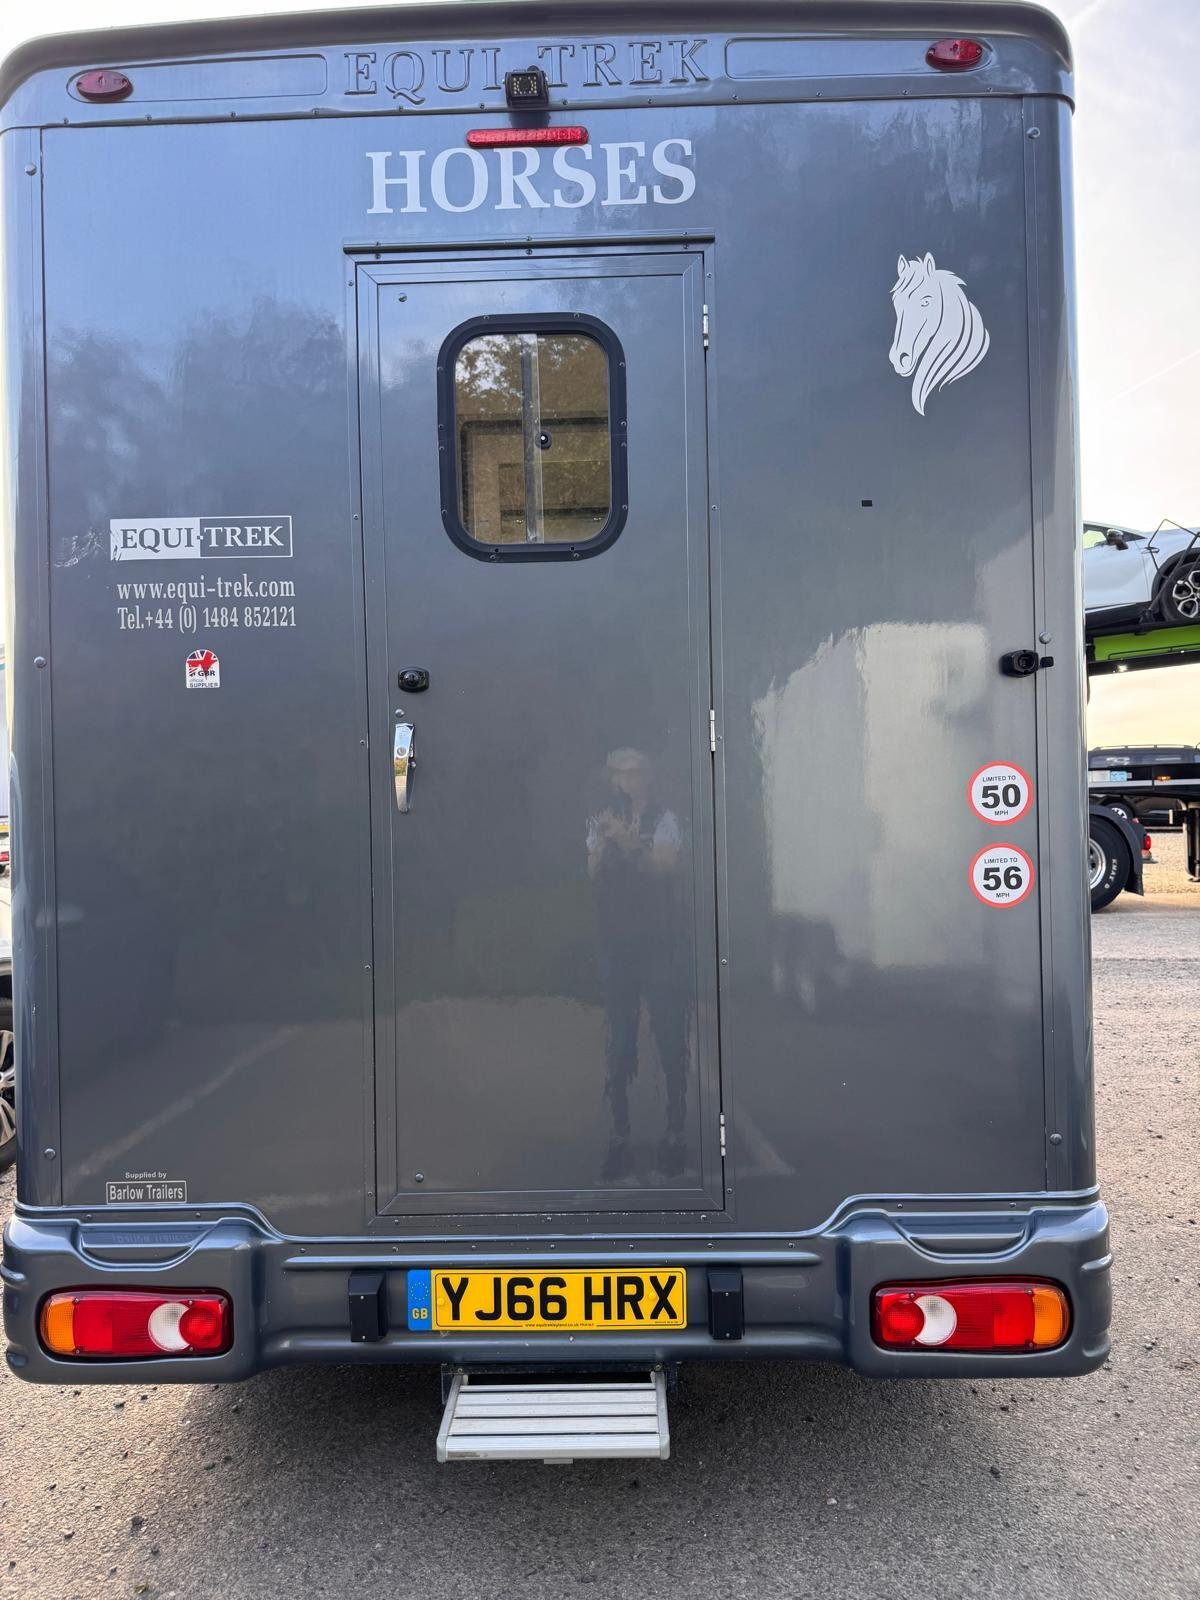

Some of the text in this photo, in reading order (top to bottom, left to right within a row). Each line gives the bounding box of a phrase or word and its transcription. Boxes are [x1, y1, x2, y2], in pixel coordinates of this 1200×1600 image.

[344, 39, 708, 104] EQUI TREK
[366, 139, 697, 215] HORSES
[117, 573, 297, 604] www.equi-trek.com
[117, 605, 297, 634] Tel.+44 (0) 1484 852121
[981, 784, 1021, 809] 50
[982, 866, 1023, 891] 56
[125, 1171, 167, 1179] Supplied by
[109, 1184, 184, 1200] Barlow Trailers
[441, 1275, 678, 1321] YJ66 HRX
[412, 1309, 428, 1320] GB
